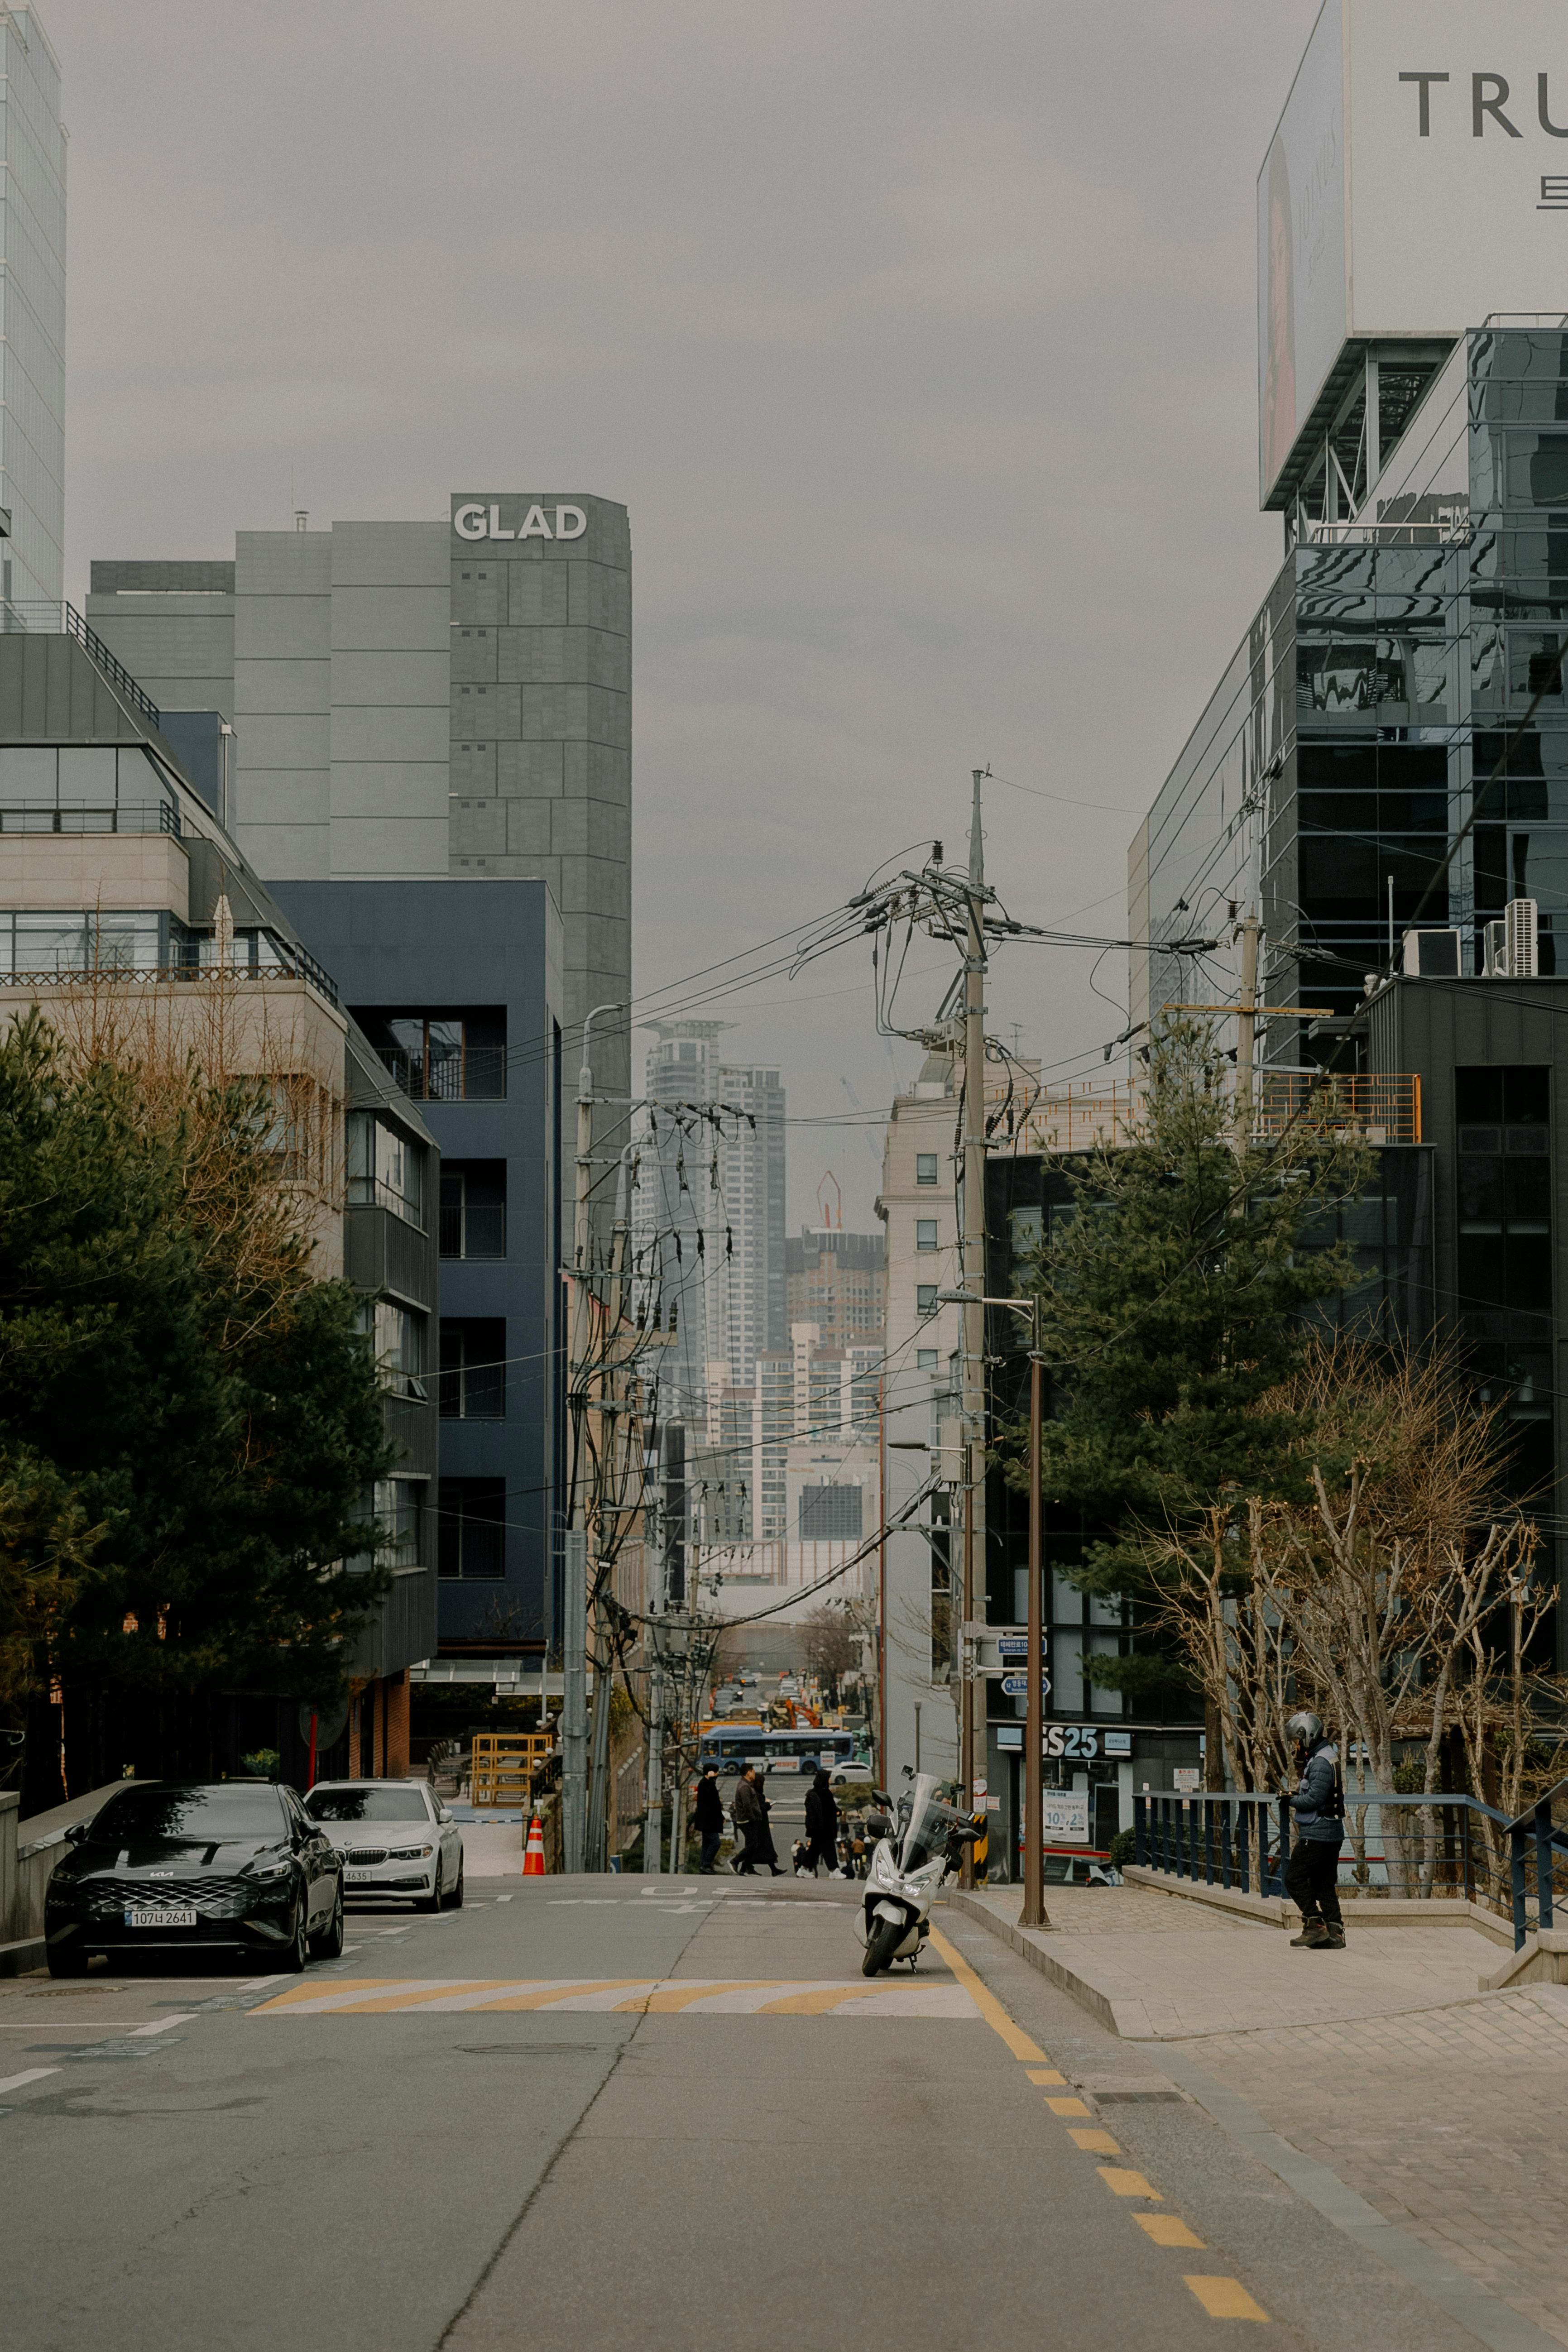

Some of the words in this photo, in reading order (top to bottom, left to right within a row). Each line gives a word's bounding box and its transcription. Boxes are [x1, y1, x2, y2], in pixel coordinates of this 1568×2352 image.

[454, 503, 587, 541] GLAD
[134, 1913, 163, 1924] 107너
[166, 1912, 192, 1924] 2641
